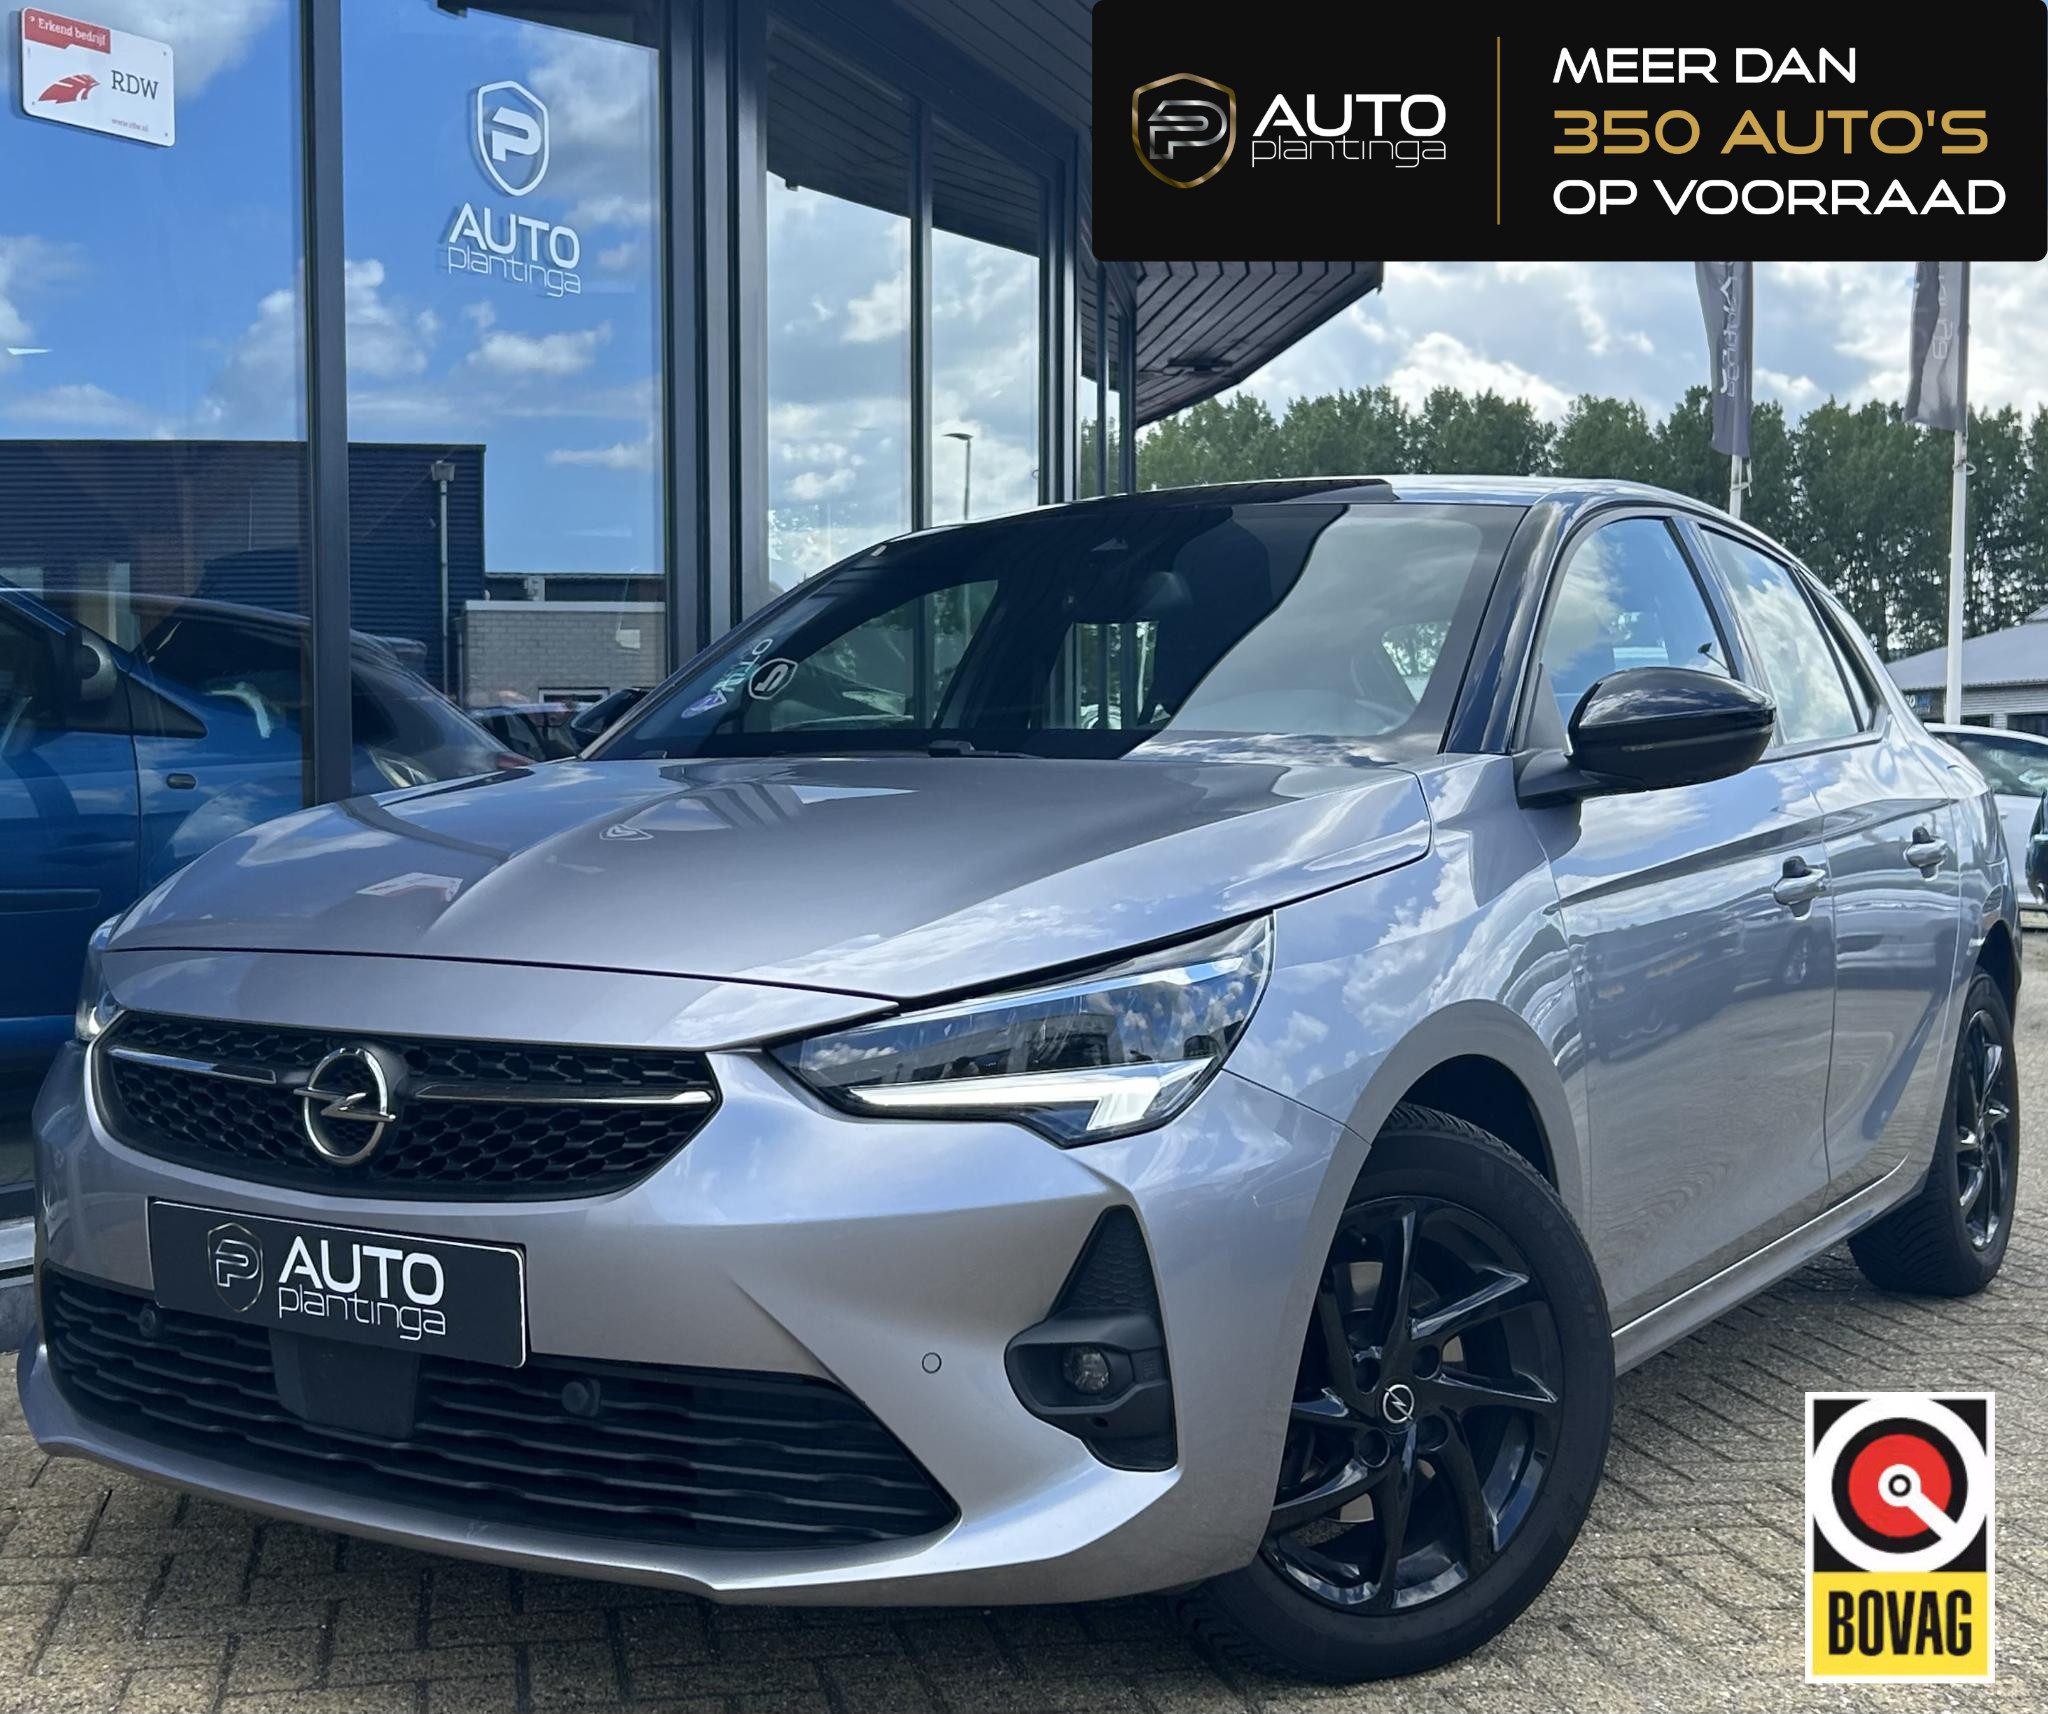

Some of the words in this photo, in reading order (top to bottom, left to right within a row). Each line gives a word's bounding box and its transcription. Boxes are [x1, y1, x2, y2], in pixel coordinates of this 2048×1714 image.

[38, 17, 73, 37] Erkend
[75, 26, 107, 47] bedrijf
[111, 69, 159, 100] RDW
[449, 202, 581, 269] AUTO
[448, 245, 581, 298] plantinga
[278, 1235, 446, 1306] AUTO
[278, 1284, 446, 1341] plantinga
